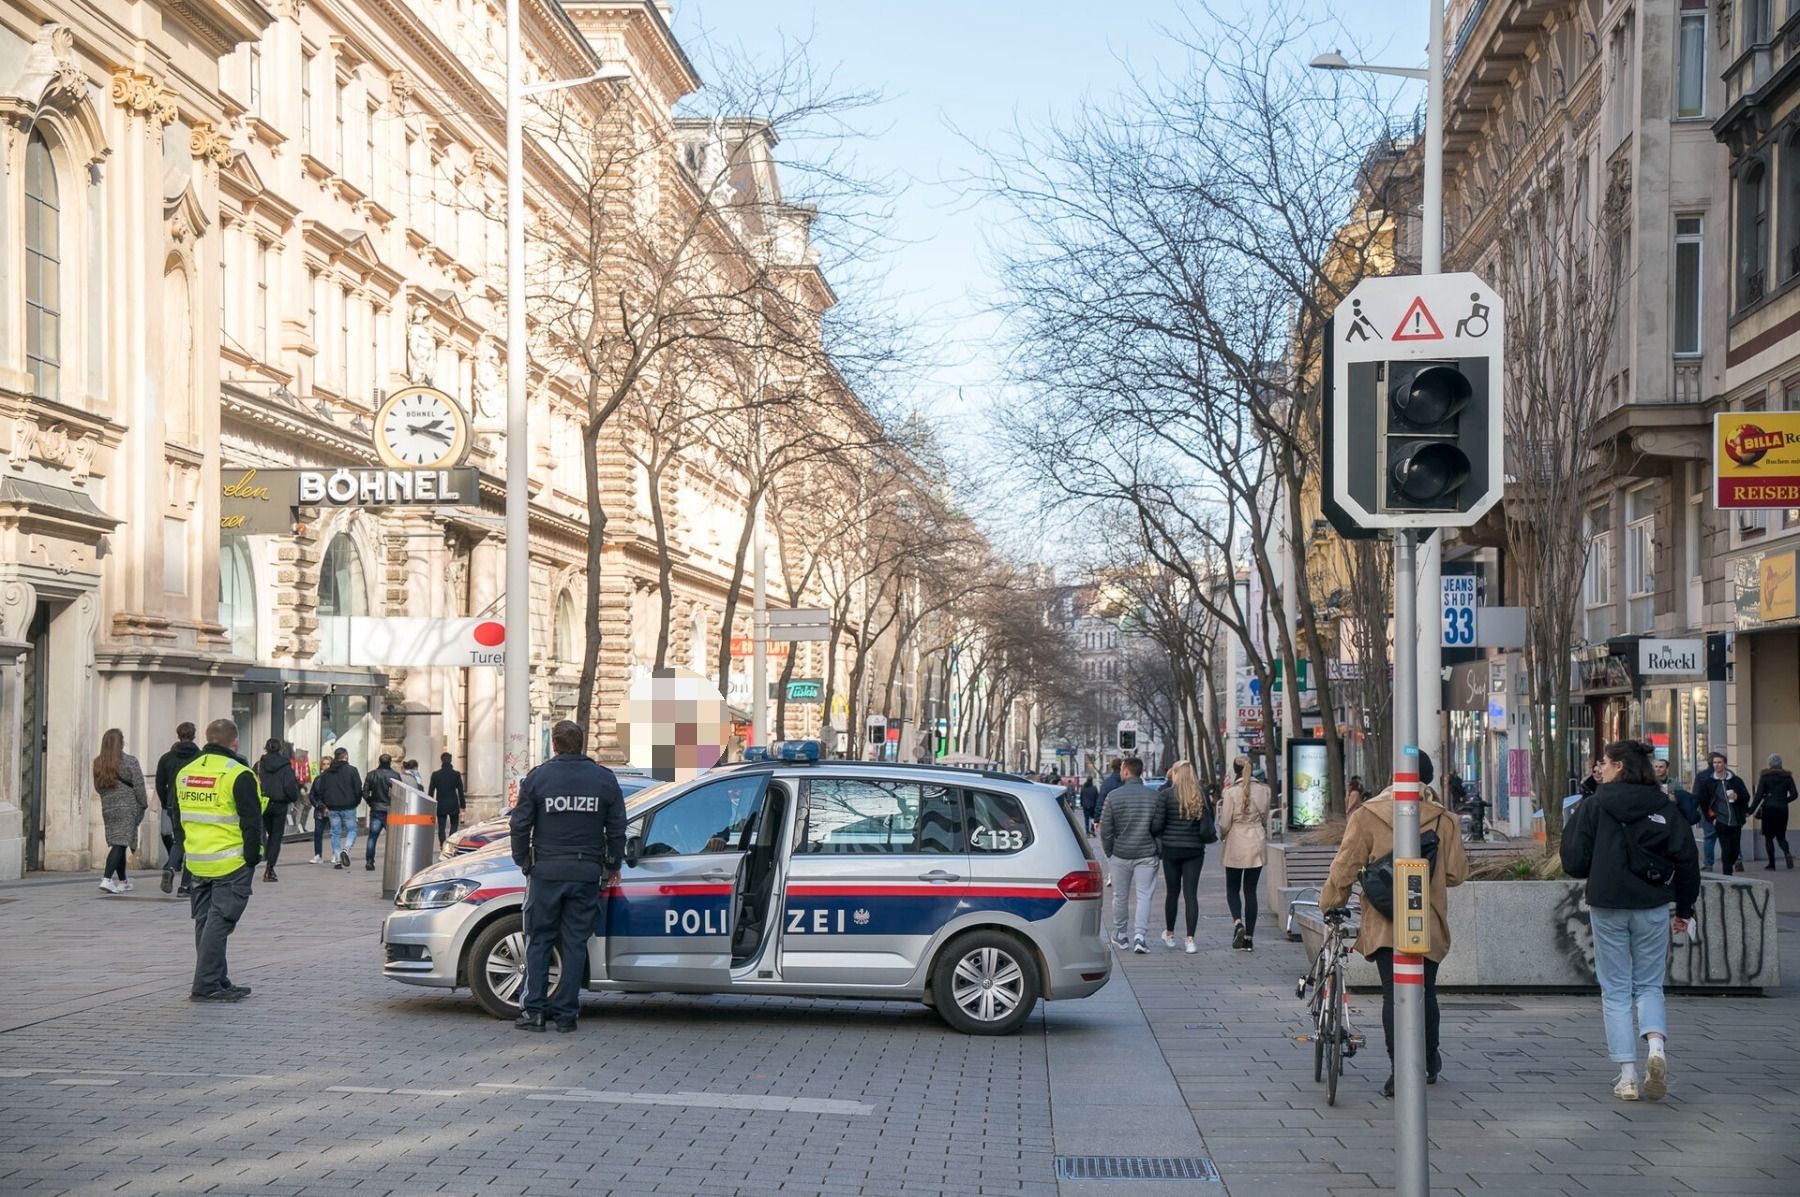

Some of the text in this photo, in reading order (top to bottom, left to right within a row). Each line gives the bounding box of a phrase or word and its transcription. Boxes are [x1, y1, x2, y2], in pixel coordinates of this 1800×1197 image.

[406, 410, 436, 418] BÖHNEL
[1744, 434, 1782, 450] BILLA
[300, 467, 461, 502] BÖHNEL
[1443, 578, 1474, 592] JEANS
[1443, 593, 1474, 606] SHOP
[1444, 607, 1474, 644] 33
[1648, 653, 1696, 670] Roeckl
[545, 796, 599, 813] POLIZEI
[988, 830, 1024, 850] 133
